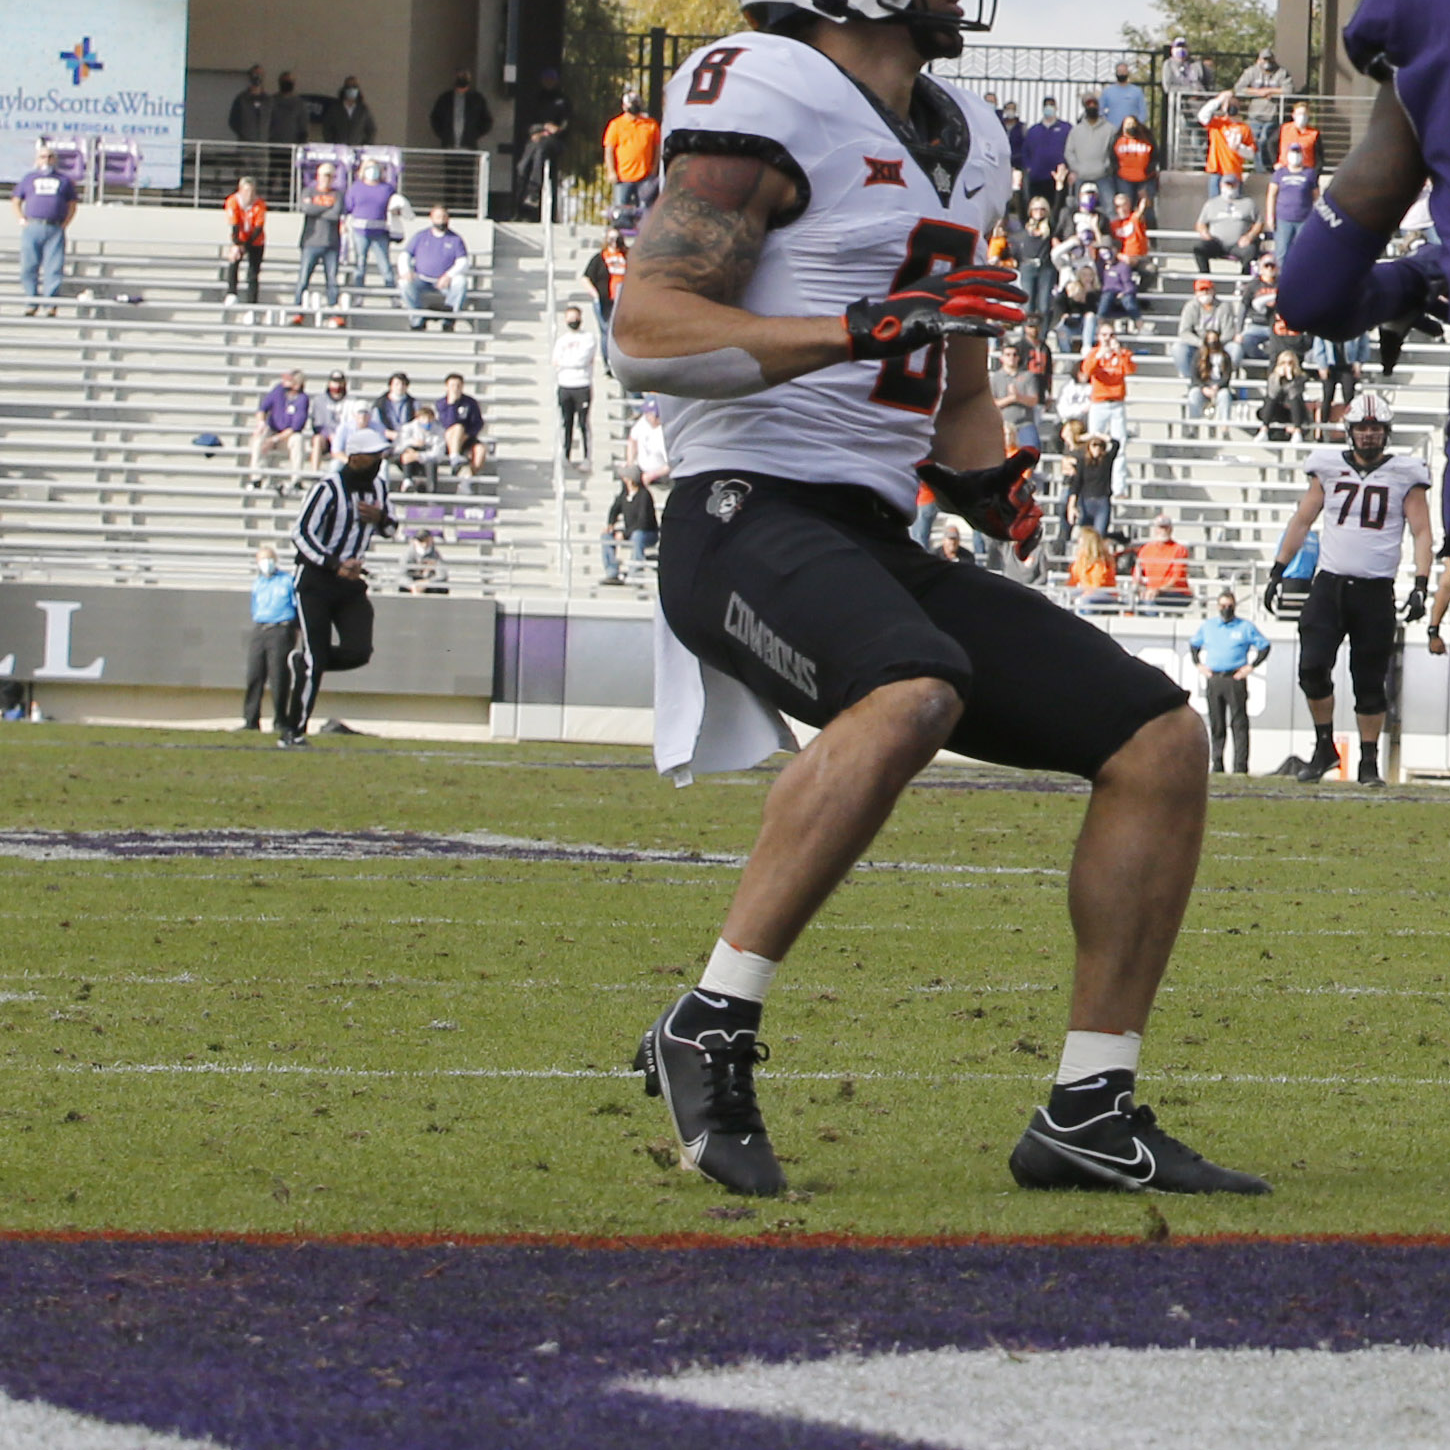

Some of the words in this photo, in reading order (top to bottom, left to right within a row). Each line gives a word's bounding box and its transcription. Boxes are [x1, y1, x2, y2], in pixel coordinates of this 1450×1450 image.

[685, 47, 752, 105] 8
[63, 123, 116, 134] MEDICAL
[121, 124, 170, 135] CENTER
[1333, 481, 1390, 531] 70
[724, 590, 818, 701] COWBOYS
